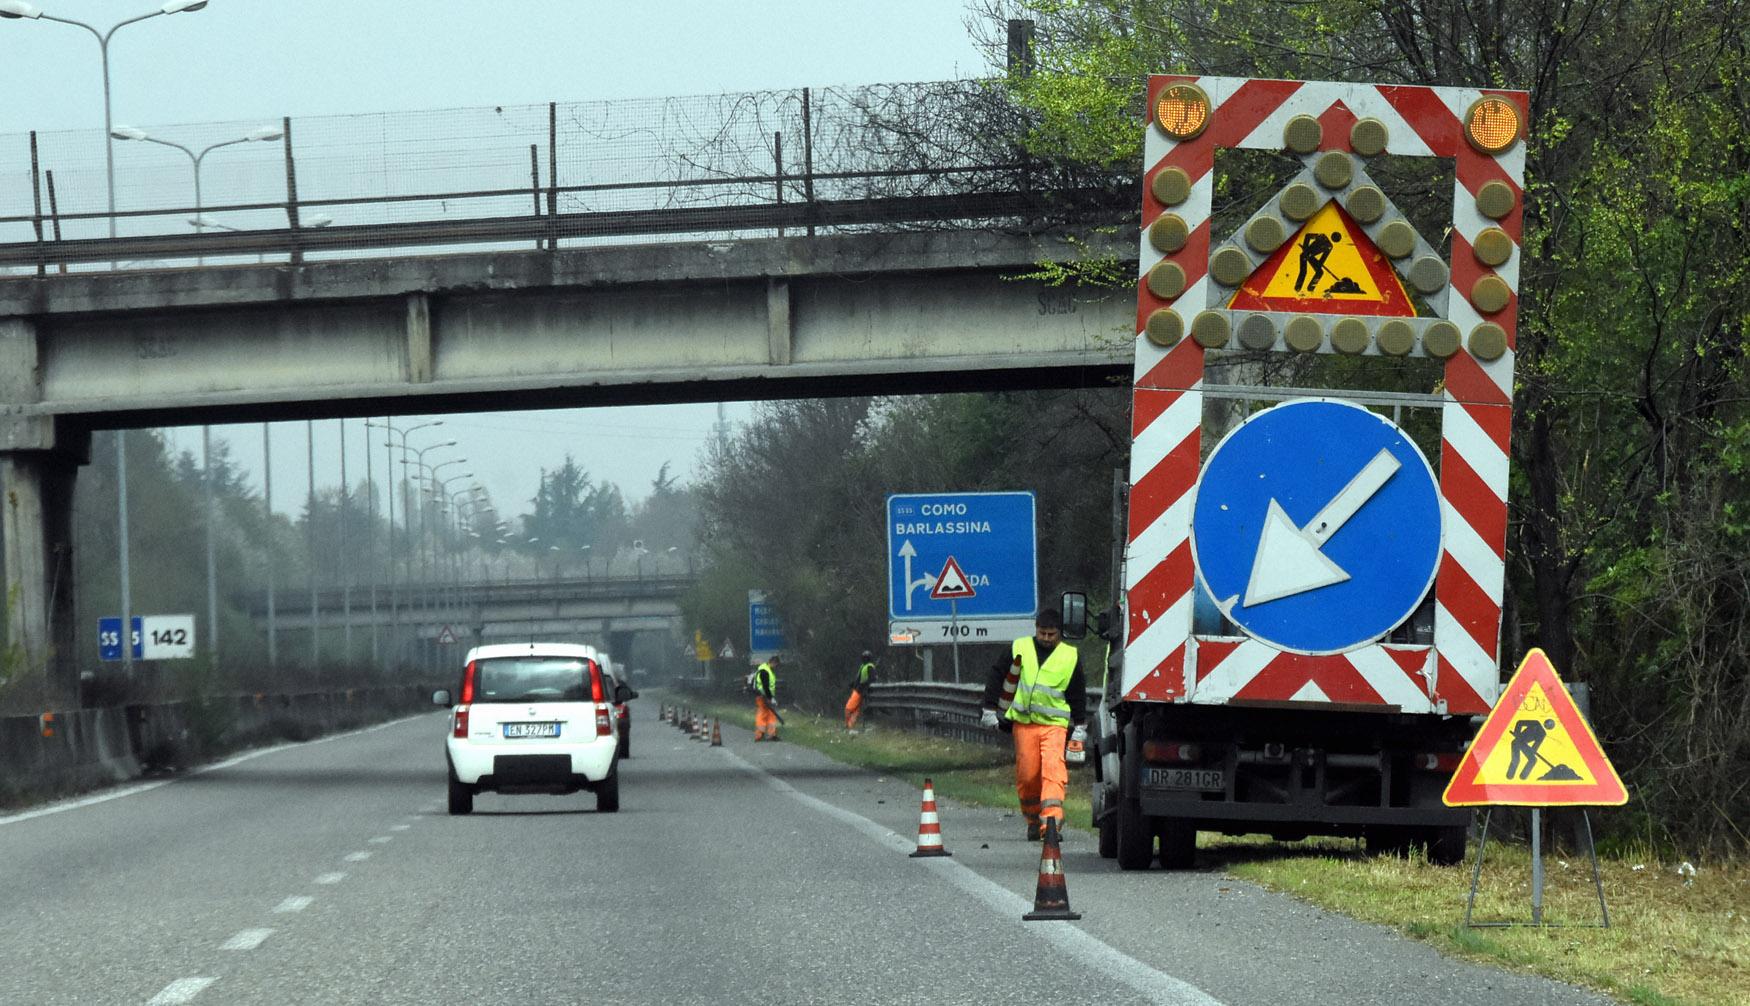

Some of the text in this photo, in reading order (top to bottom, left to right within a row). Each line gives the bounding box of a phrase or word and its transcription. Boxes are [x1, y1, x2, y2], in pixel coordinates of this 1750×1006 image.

[921, 503, 967, 516] COMO
[896, 521, 991, 535] BARLASSINA
[967, 574, 990, 587] DA
[151, 629, 186, 646] 142
[941, 625, 988, 637] 700 m
[101, 631, 119, 646] SS
[1151, 769, 1169, 785] DR
